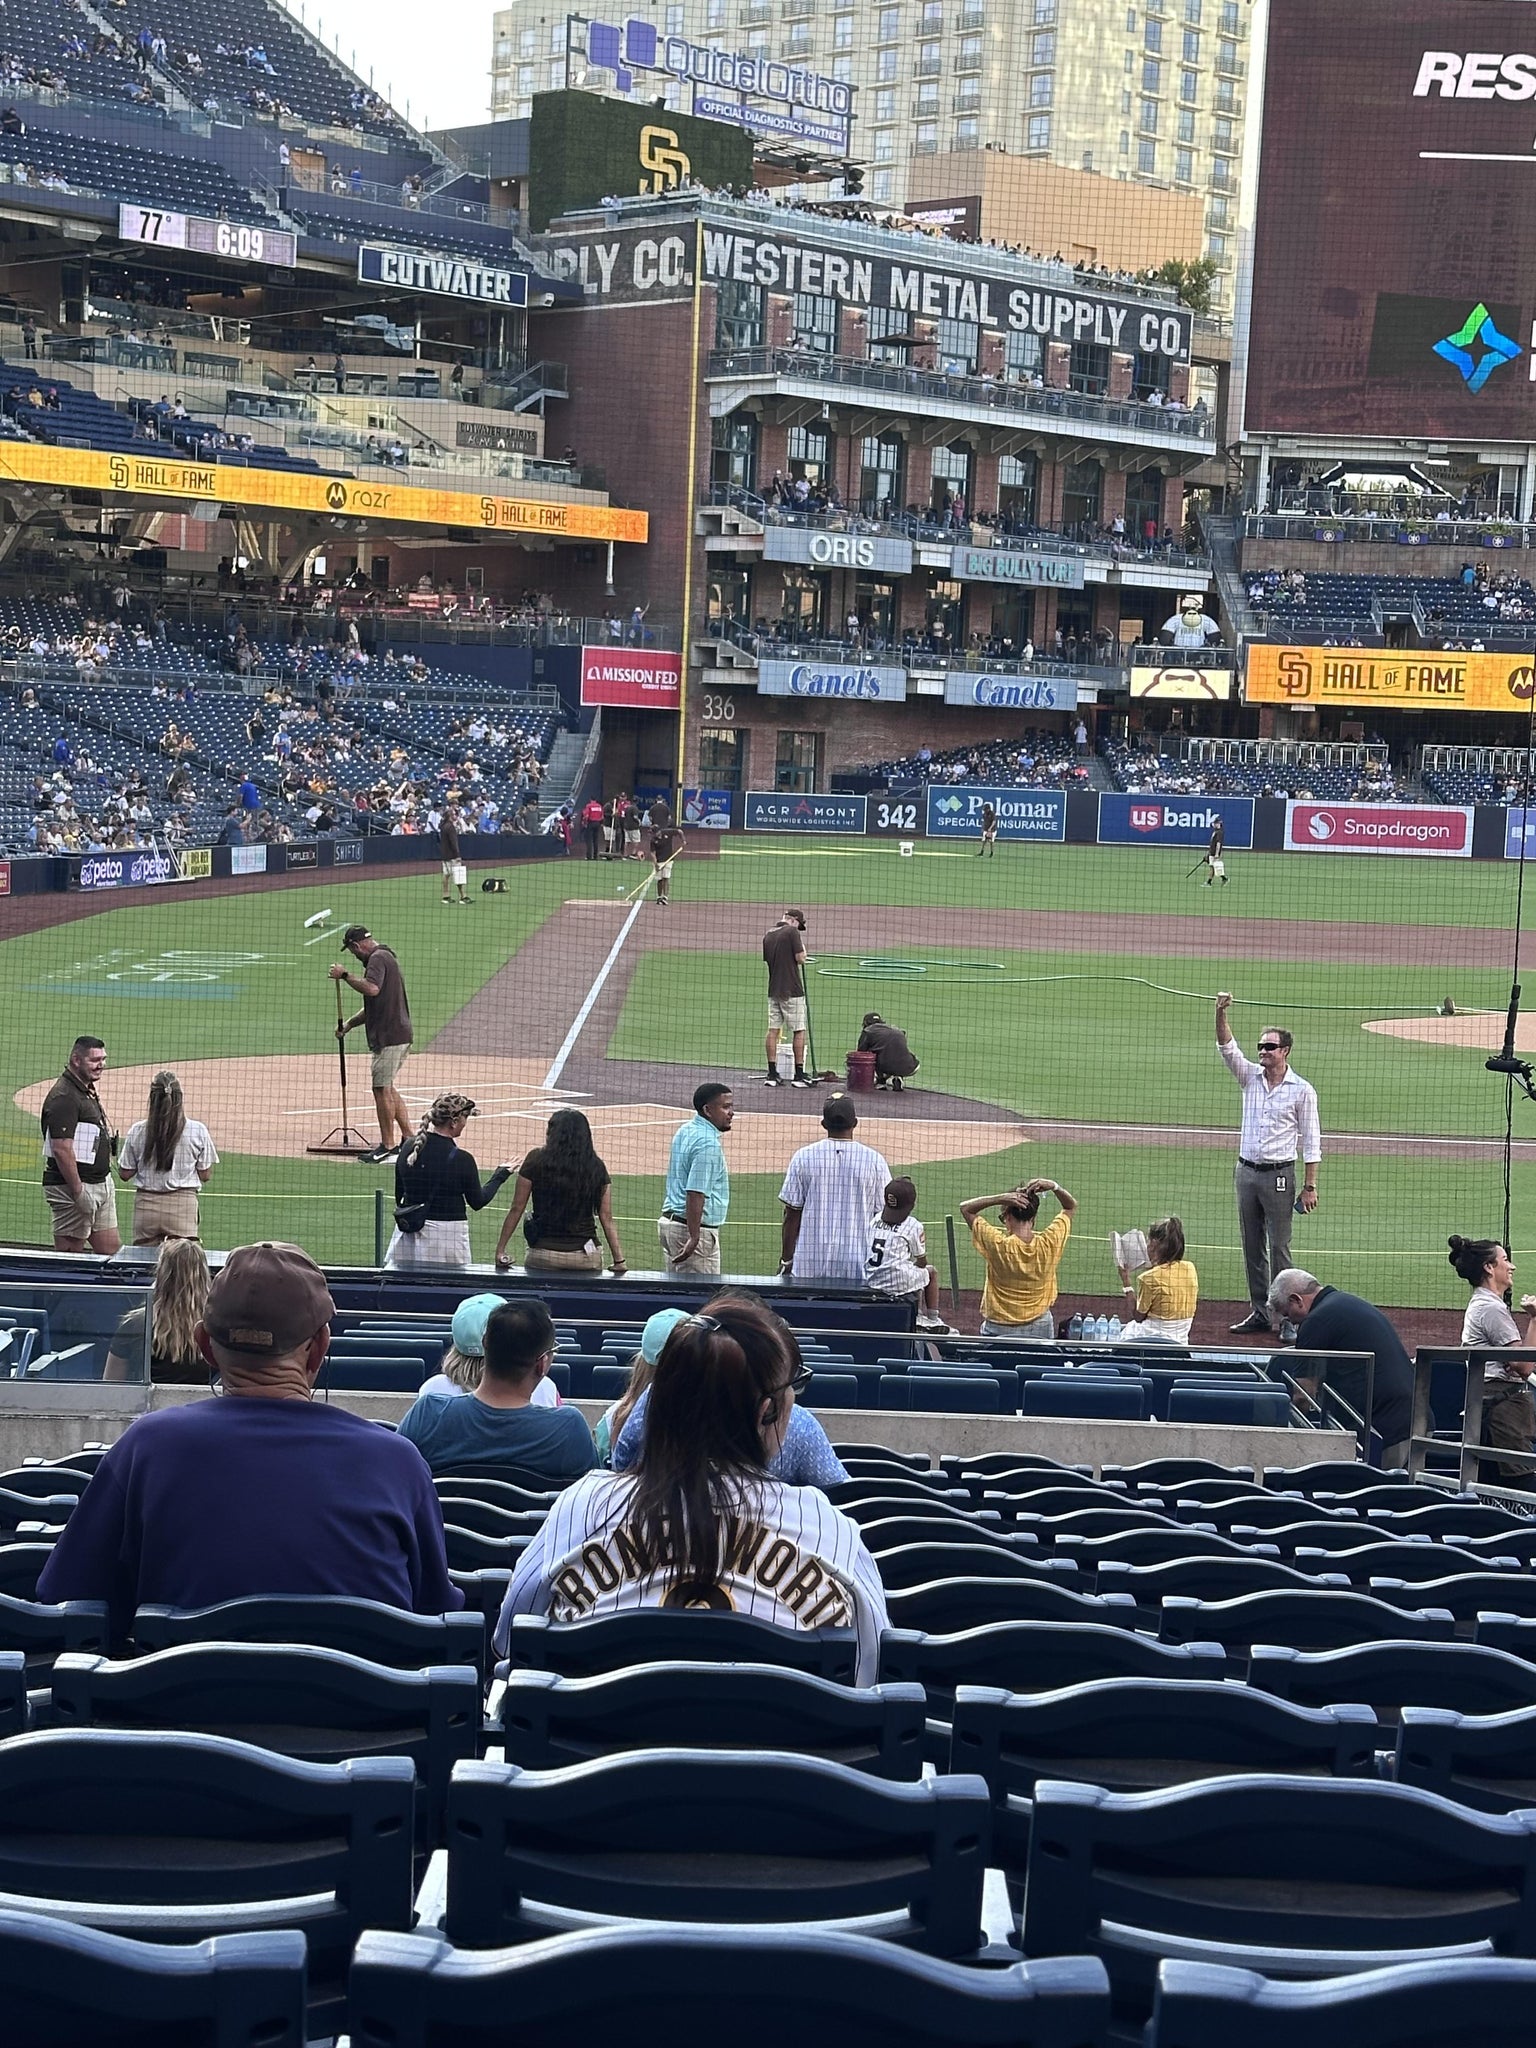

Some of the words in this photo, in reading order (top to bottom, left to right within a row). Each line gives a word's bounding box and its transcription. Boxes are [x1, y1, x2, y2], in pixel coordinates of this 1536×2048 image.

[664, 35, 850, 114] QuidelOrtho
[702, 102, 743, 121] OFFICIAL
[745, 111, 803, 134] DIAGNOSTICS
[804, 123, 843, 143] PARTNER
[217, 223, 263, 260] 6:09
[380, 252, 511, 302] CUTWATER
[633, 236, 694, 291] CO.
[702, 229, 873, 303] WESTERN
[890, 266, 998, 326] METAL
[1008, 289, 1128, 347] SUPPLY
[1138, 313, 1187, 358] CO.
[136, 465, 168, 486] HALL
[182, 470, 216, 491] FAME
[353, 490, 391, 509] razr
[502, 505, 528, 523] HALL
[539, 509, 567, 528] FAME
[809, 535, 875, 566] ORIS
[967, 553, 994, 575] BIG
[995, 557, 1036, 580] BULLY
[1040, 561, 1076, 583] TURF
[602, 667, 653, 684] MISSION
[655, 671, 678, 685] FED
[789, 665, 882, 698] Canel's
[1323, 663, 1379, 690] HALL
[1384, 671, 1398, 685] OF
[1405, 666, 1466, 693] FAME
[973, 677, 1057, 708] Canel's
[702, 694, 735, 721] 336
[756, 816, 801, 824] WORLDWIDE
[878, 804, 917, 828] 342
[937, 816, 990, 828] SPECIAL
[997, 820, 1059, 831] INSURANCE
[1132, 809, 1159, 826] us
[1163, 806, 1221, 829] bank
[1344, 818, 1450, 840] Snapdragon
[93, 857, 123, 885] petco
[868, 1238, 886, 1267] 5
